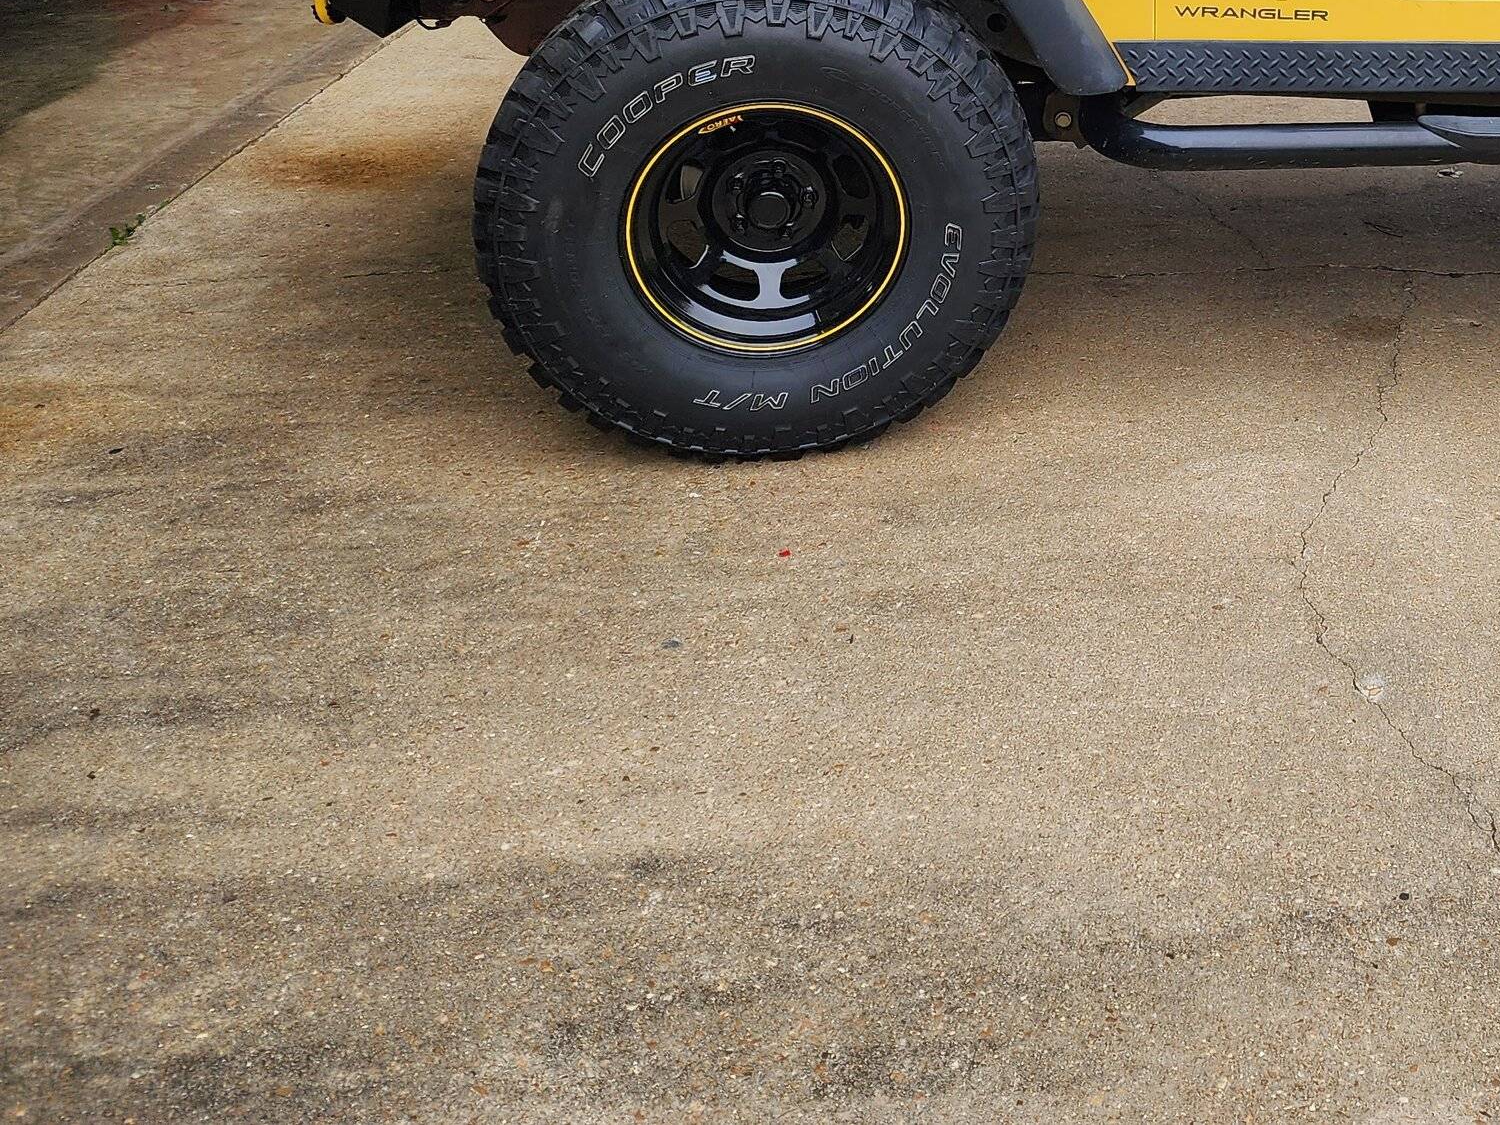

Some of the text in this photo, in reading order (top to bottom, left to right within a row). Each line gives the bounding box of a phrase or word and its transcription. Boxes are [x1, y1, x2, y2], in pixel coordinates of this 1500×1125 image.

[1175, 5, 1329, 21] WRANGLER
[578, 55, 755, 177] COOPER
[693, 221, 964, 411] EVOLUTION M/T
